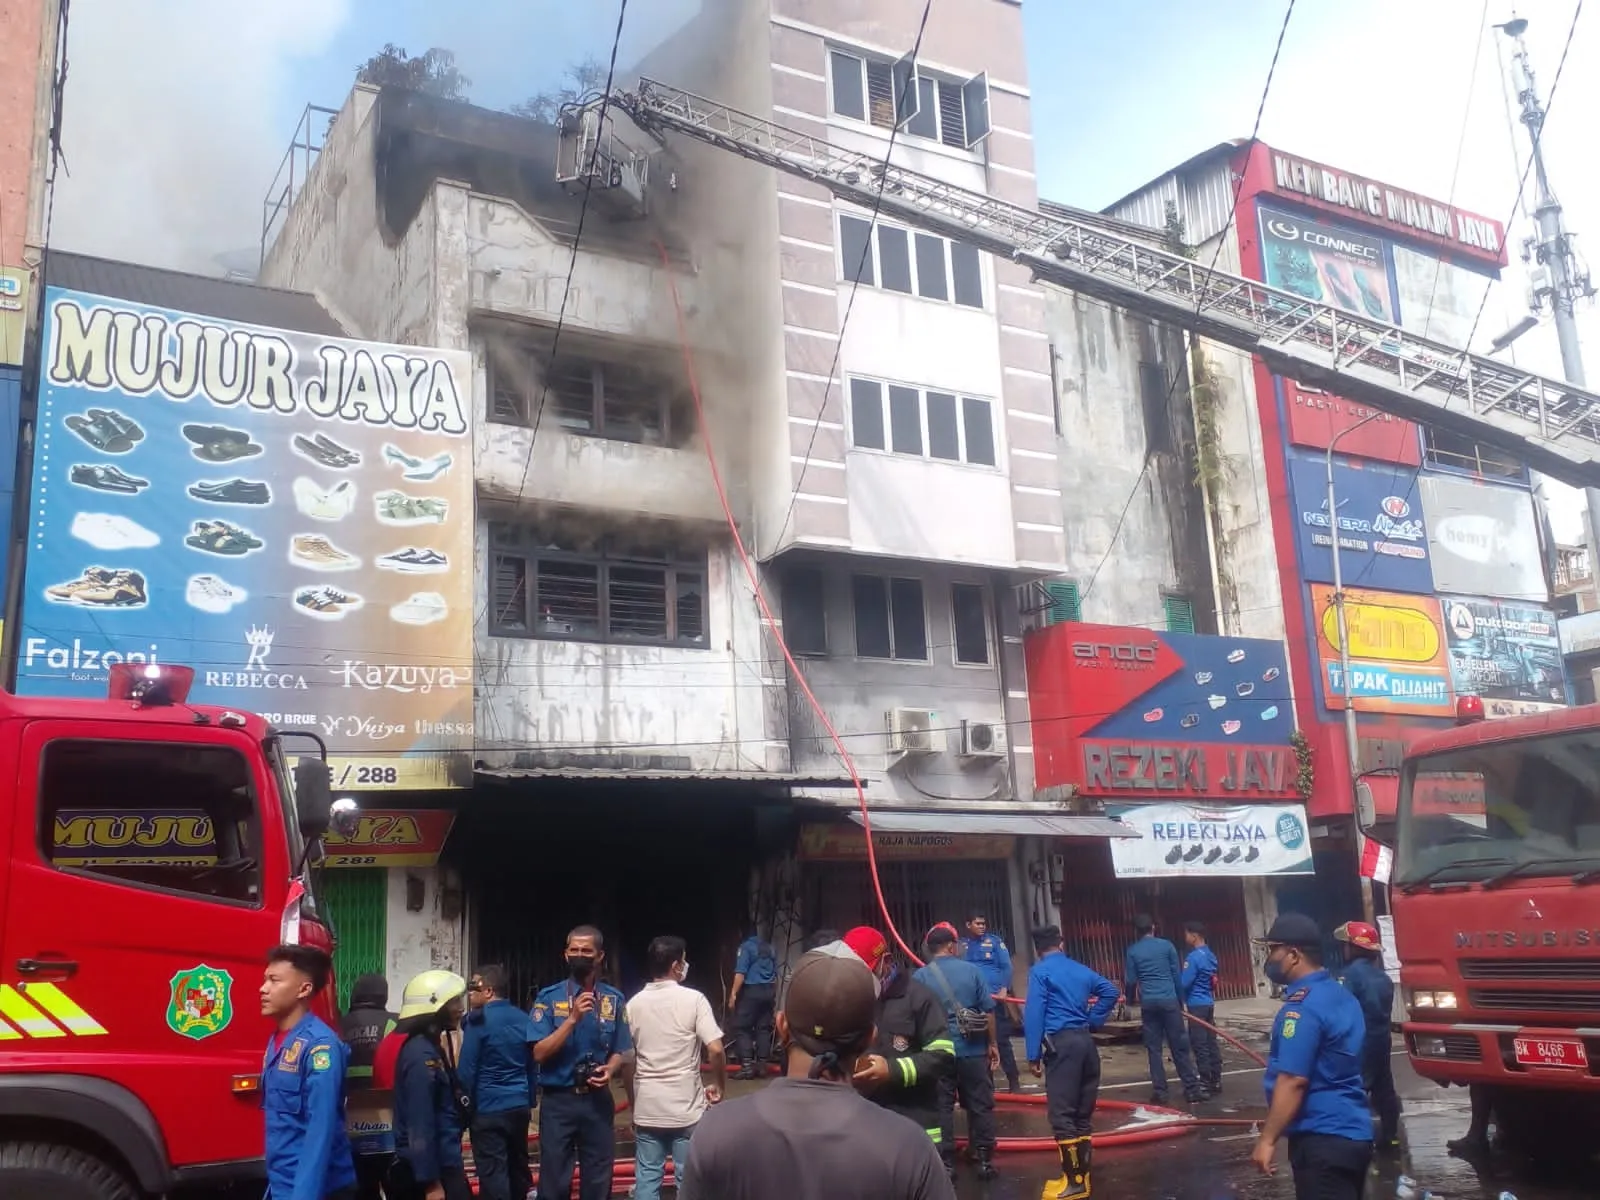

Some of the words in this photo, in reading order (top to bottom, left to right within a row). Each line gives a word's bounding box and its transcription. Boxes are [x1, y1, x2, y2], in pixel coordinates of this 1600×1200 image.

[1274, 155, 1383, 217] KEMBANG
[1456, 213, 1500, 252] JAYA
[49, 301, 296, 412] MUJUR
[305, 345, 467, 435] JAYA
[1072, 641, 1155, 663] ando
[205, 670, 308, 690] REBECCA
[330, 659, 471, 694] Kazuya
[1331, 668, 1388, 691] TPAK
[356, 767, 397, 784] 288
[1082, 744, 1208, 792] REZEKI
[1220, 750, 1299, 792] JAYA
[1152, 822, 1218, 841] REJEKI
[1222, 824, 1267, 842] JAYA
[335, 856, 377, 865] 288
[1537, 1043, 1565, 1058] 8466
